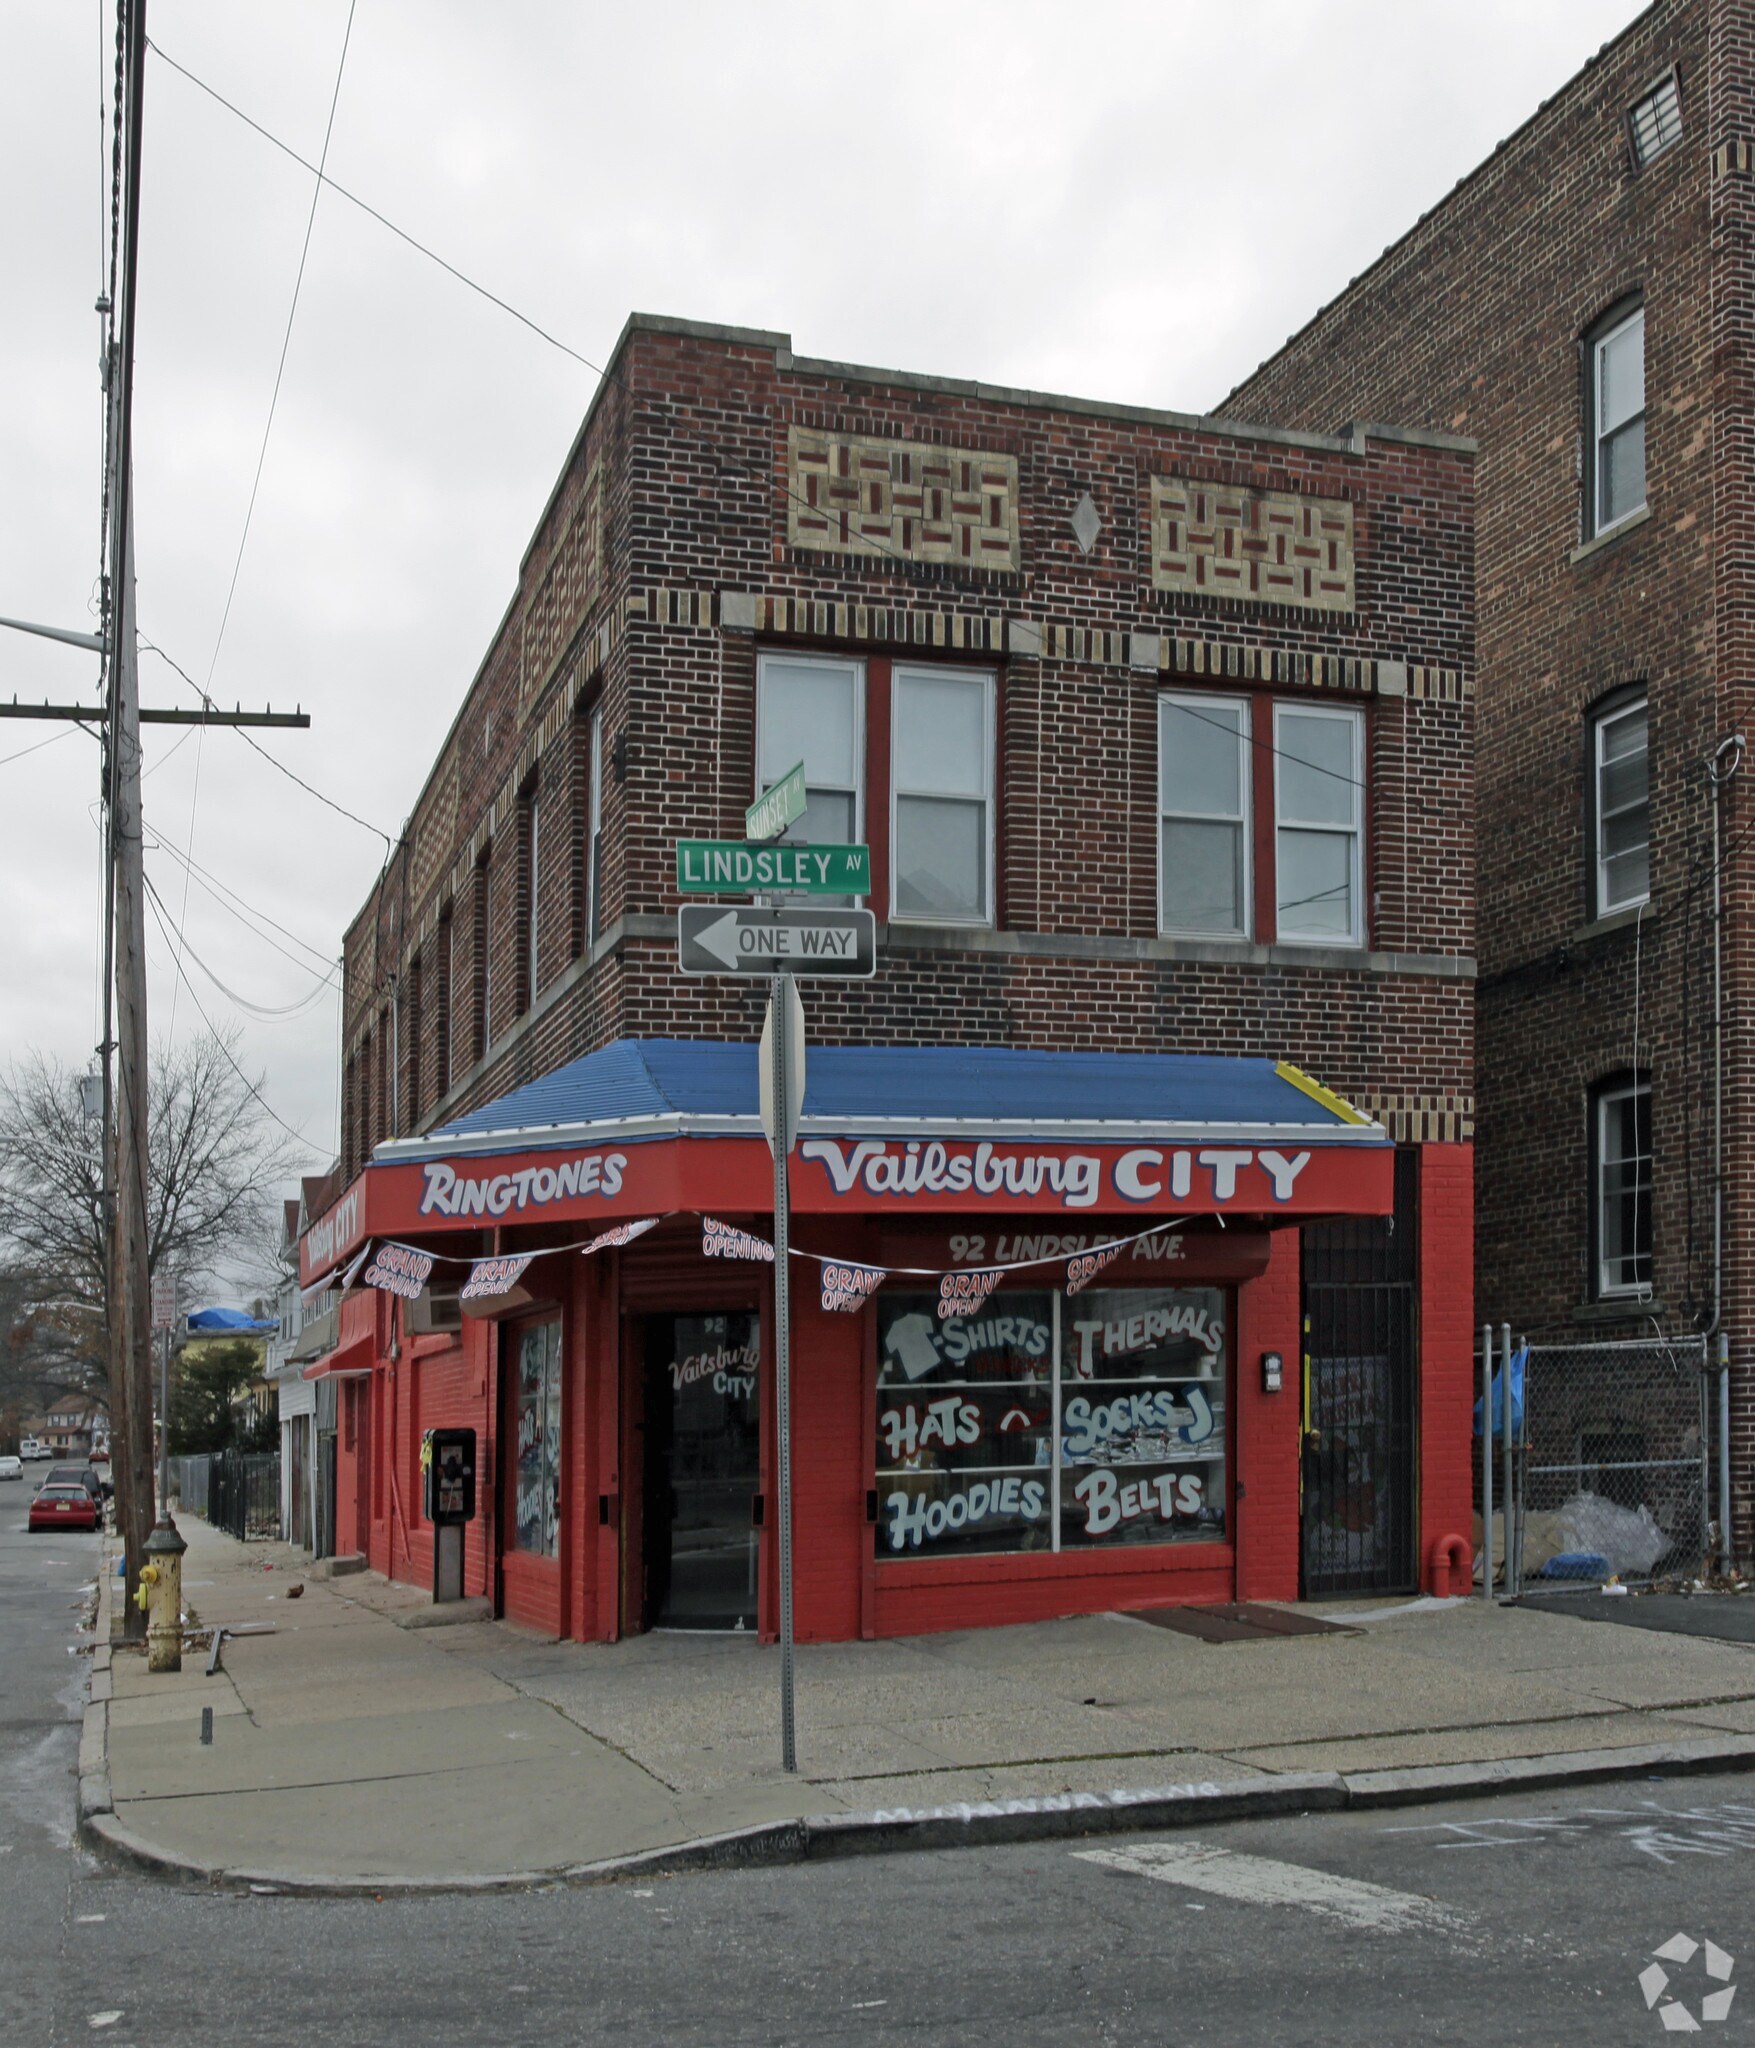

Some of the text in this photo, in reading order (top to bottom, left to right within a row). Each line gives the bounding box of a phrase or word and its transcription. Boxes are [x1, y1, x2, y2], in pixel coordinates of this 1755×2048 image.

[750, 784, 789, 839] SUNSET
[684, 850, 862, 884] LINDSLEY AV
[739, 928, 853, 955] ONE WAY
[419, 1153, 628, 1216] RINGTONES
[802, 1140, 1311, 1207] Vailsburg CITY
[335, 1190, 357, 1254] CITY
[376, 1244, 433, 1281] GRAND
[702, 1234, 775, 1262] OPENING
[949, 1235, 986, 1261] 92
[1132, 1235, 1187, 1260] AVE.
[364, 1264, 423, 1299] OPENING
[703, 1316, 724, 1333] 92
[1073, 1306, 1225, 1378] THERMALS
[667, 1344, 760, 1391] Vailsburg
[712, 1371, 756, 1399] CITY
[880, 1396, 982, 1460] HATS
[1063, 1389, 1175, 1456] SOCKS
[886, 1477, 1046, 1550] HOODIES
[1074, 1469, 1202, 1536] BELTS
